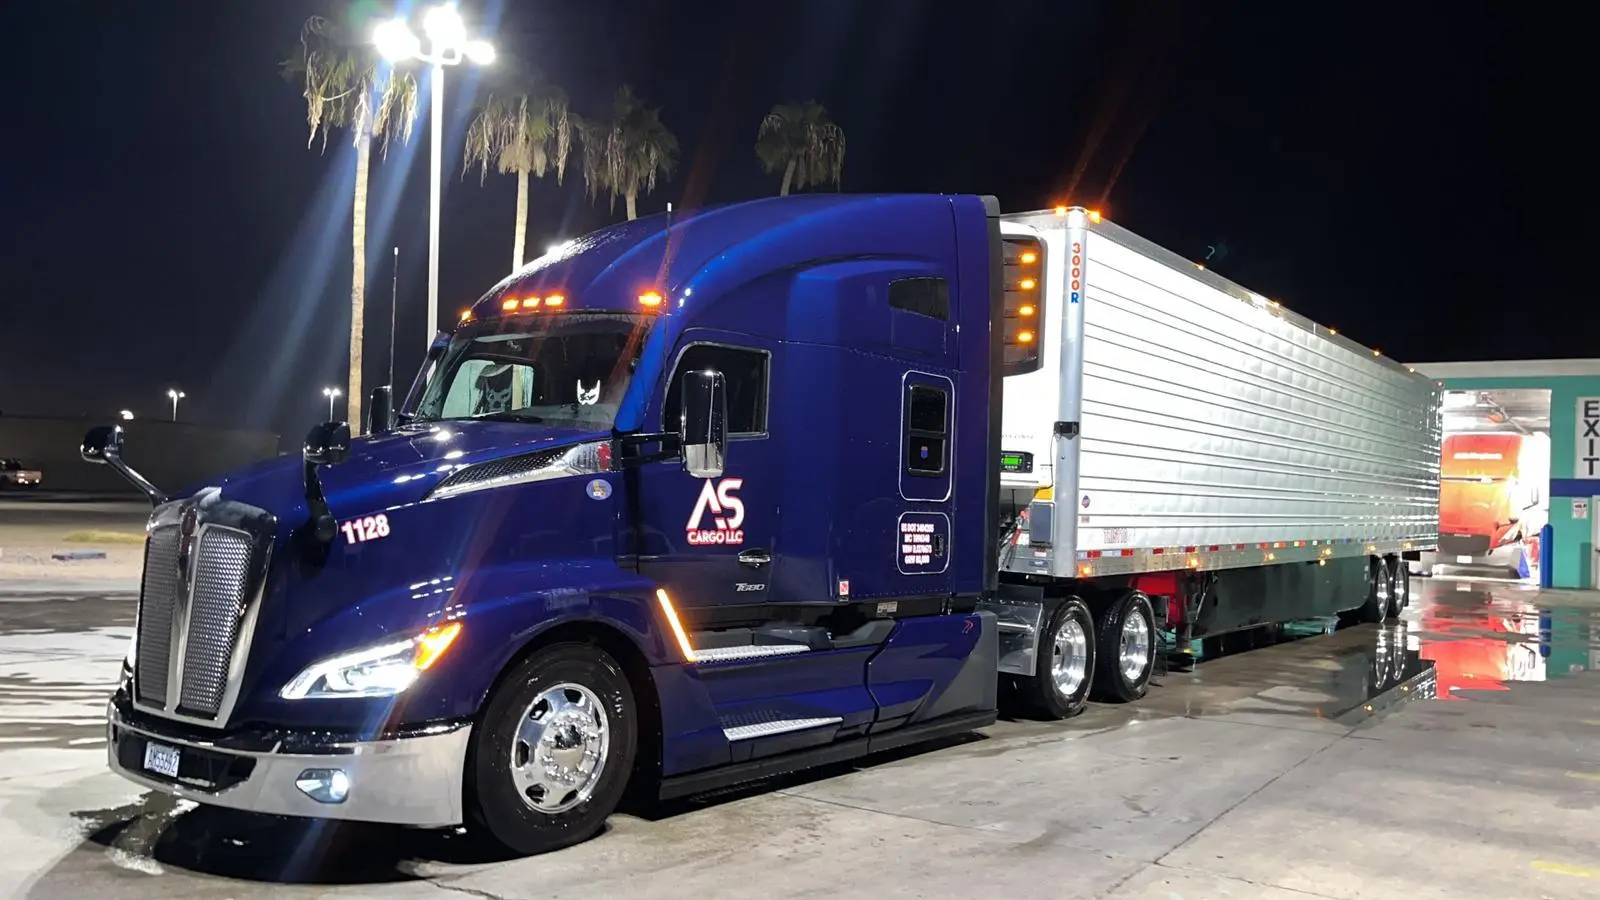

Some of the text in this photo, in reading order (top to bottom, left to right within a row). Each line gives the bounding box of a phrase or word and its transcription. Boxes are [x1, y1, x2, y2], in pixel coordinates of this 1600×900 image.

[1071, 242, 1081, 303] 3000R
[1583, 400, 1600, 475] EXIT
[341, 513, 390, 544] 1128
[686, 478, 744, 531] AS
[687, 530, 744, 545] CARGO LLC
